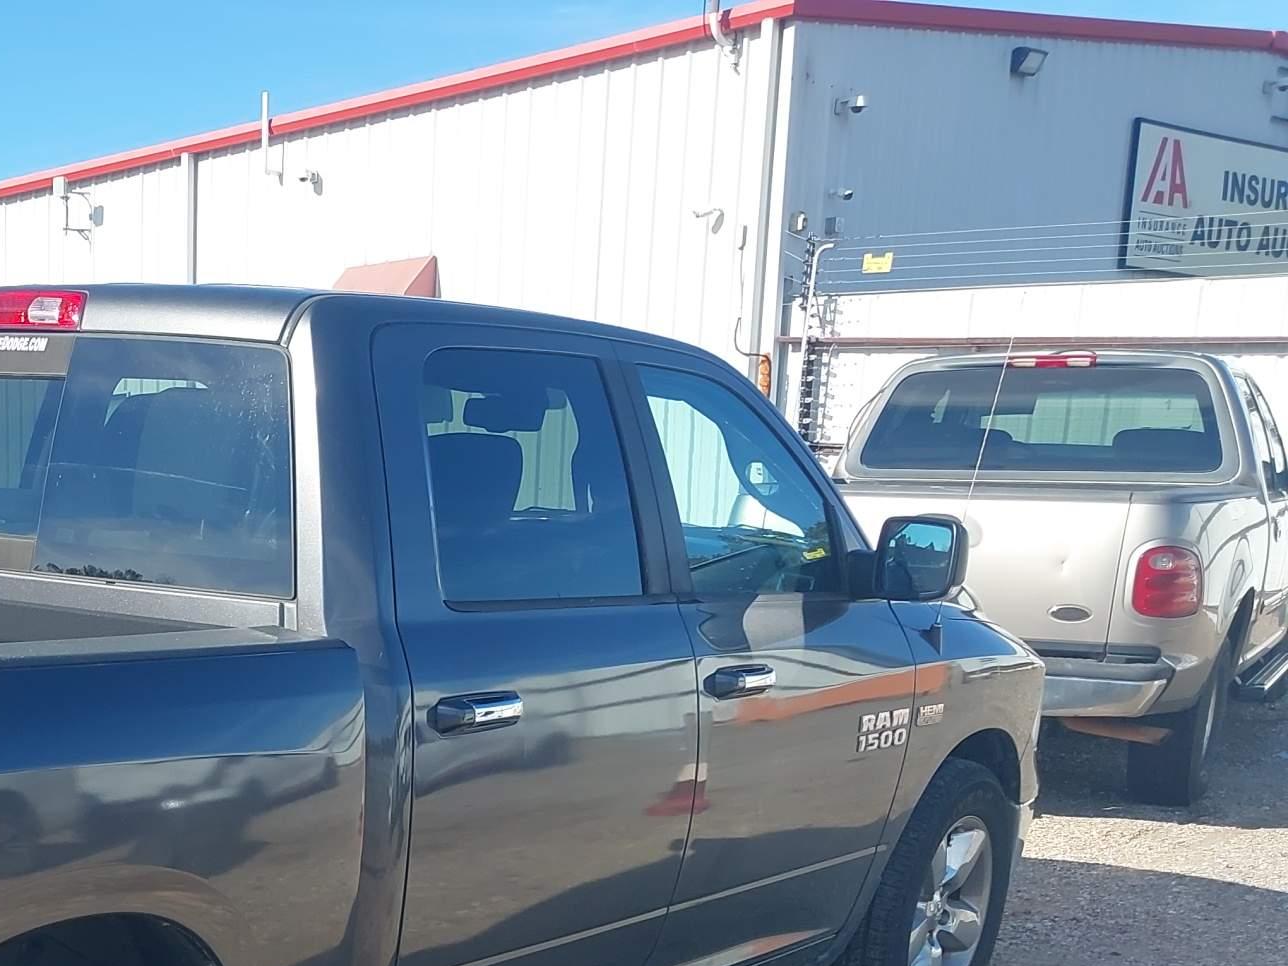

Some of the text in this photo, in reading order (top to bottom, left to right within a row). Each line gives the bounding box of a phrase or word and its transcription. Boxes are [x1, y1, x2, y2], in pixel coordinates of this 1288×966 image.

[1137, 217, 1187, 236] INSURANCE
[1190, 215, 1288, 258] AUTO AU
[861, 708, 909, 732] RAM
[919, 704, 944, 716] HEMI
[858, 728, 907, 752] 1500
